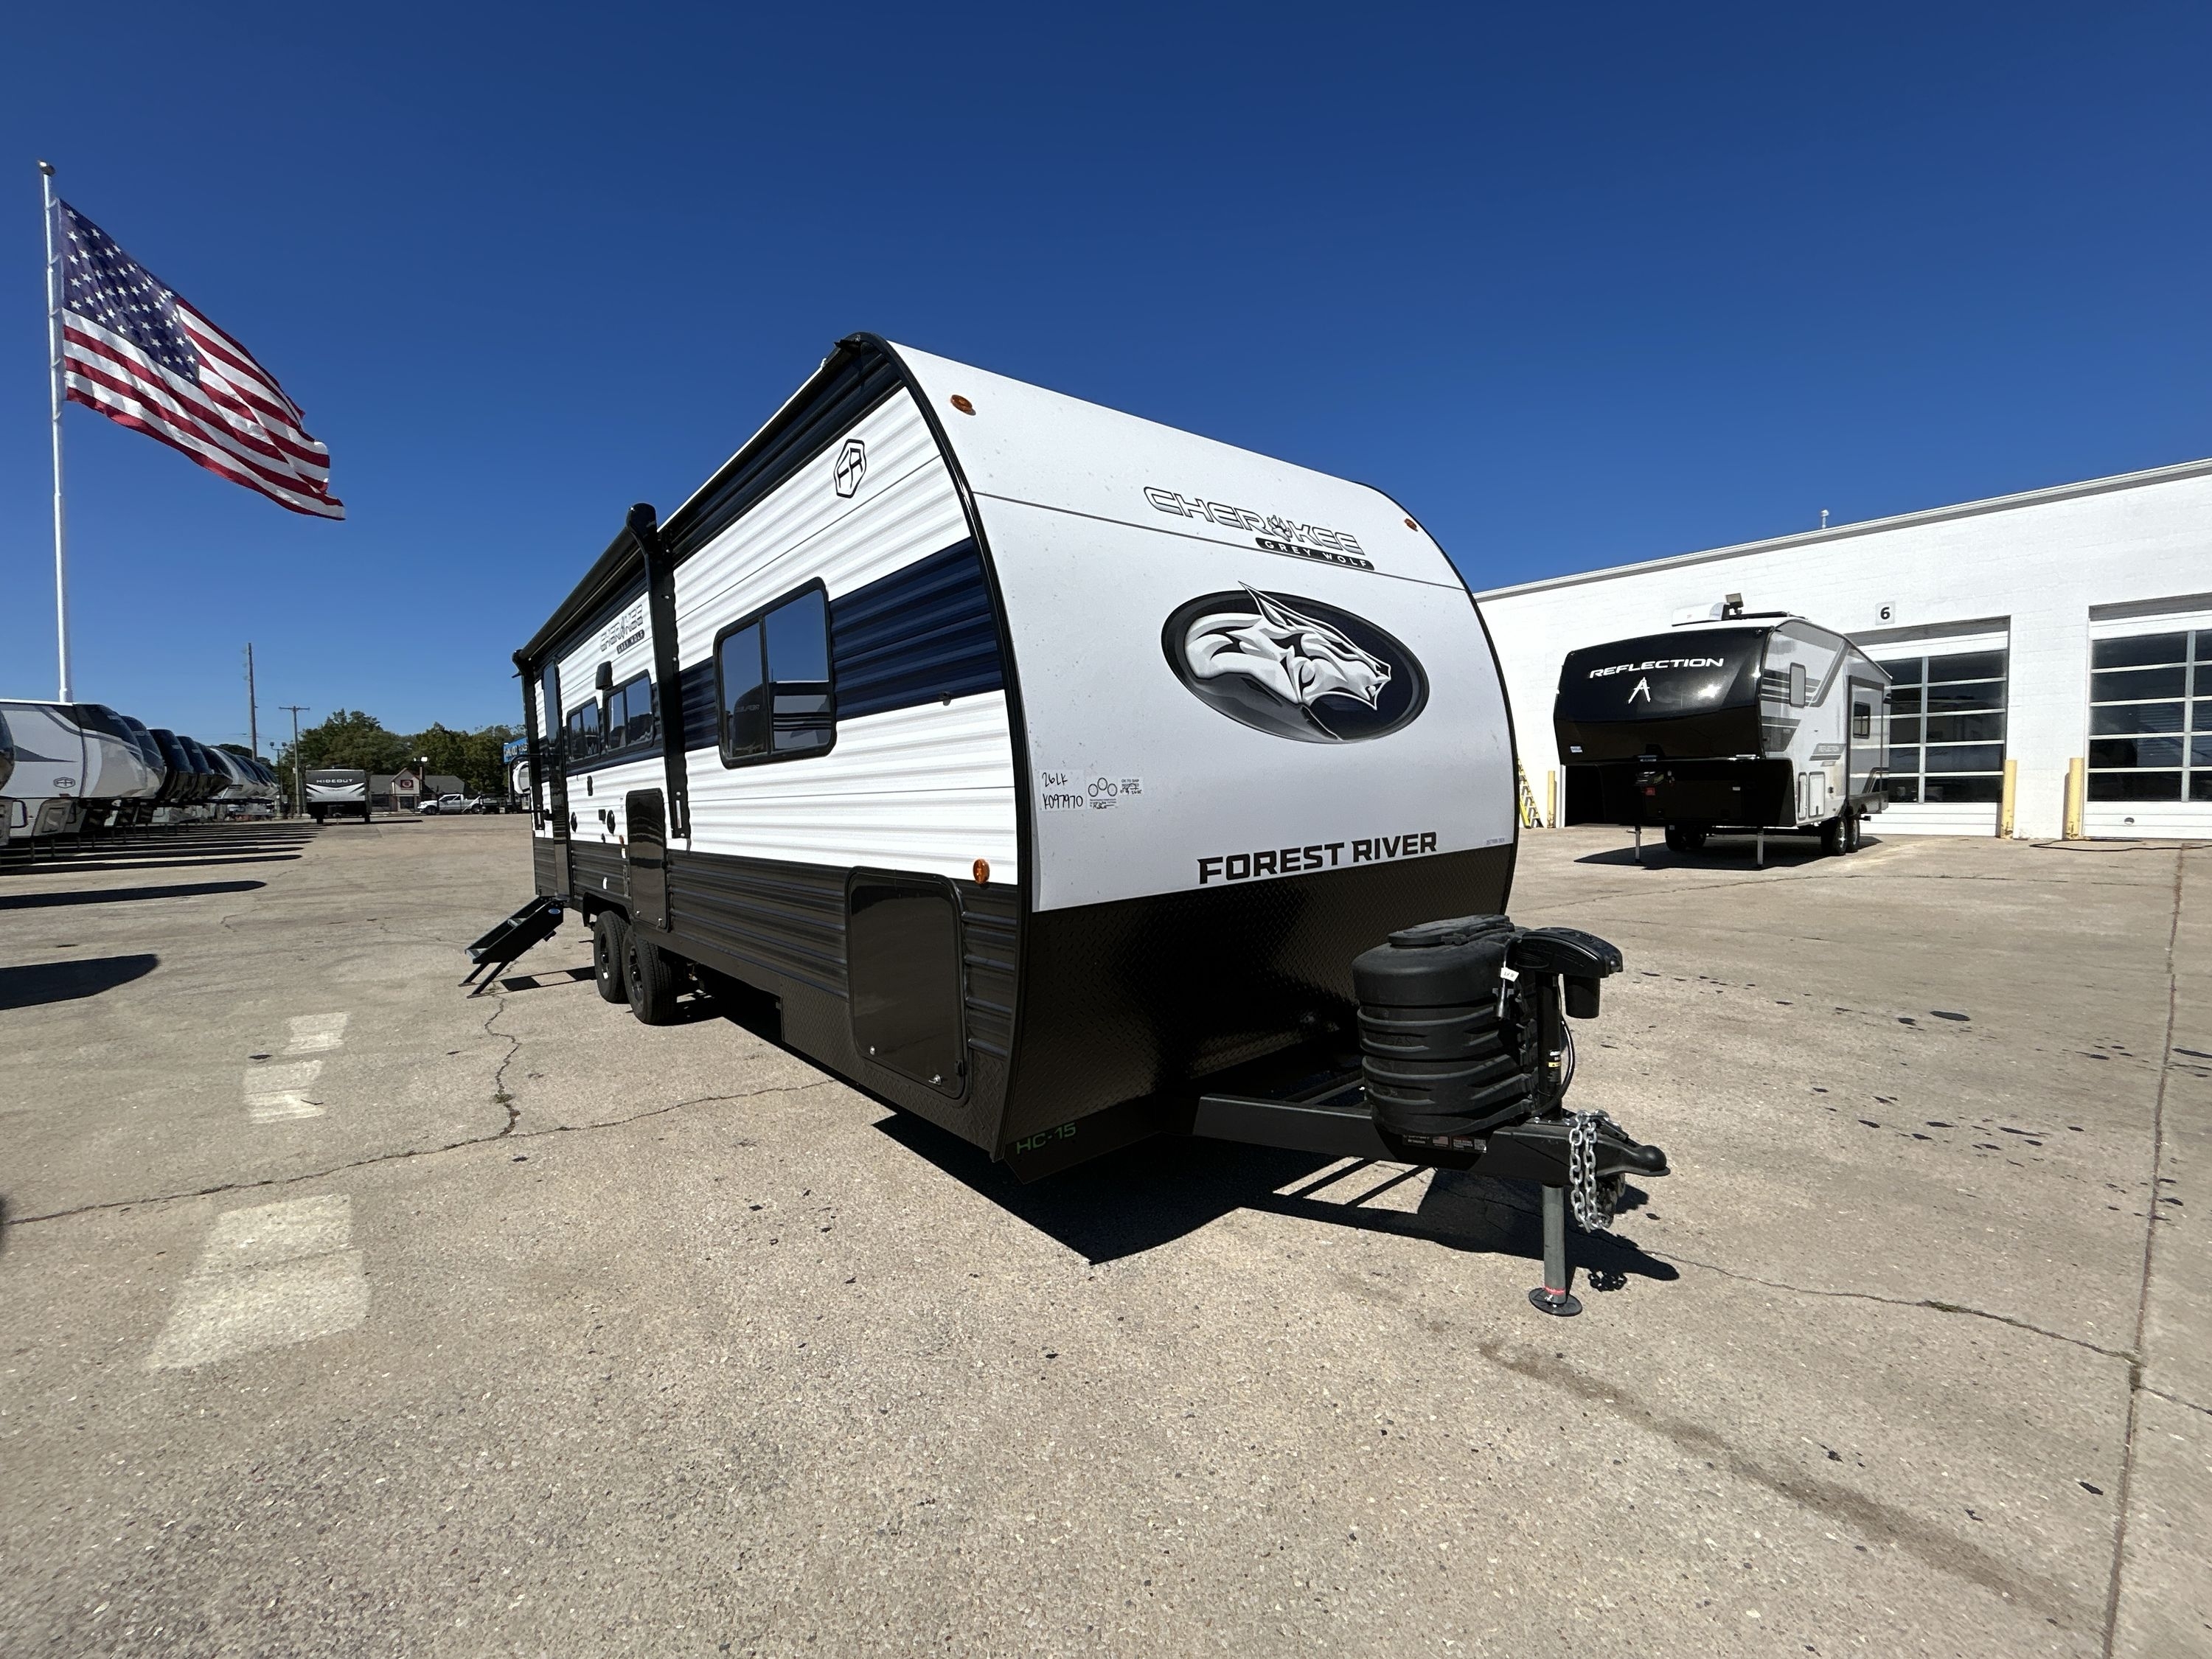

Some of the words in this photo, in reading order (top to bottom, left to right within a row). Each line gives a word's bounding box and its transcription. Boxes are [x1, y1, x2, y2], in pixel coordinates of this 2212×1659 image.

[1265, 541, 1311, 555] GREY
[1323, 552, 1367, 566] WOLF
[1880, 606, 1891, 620] 6
[1589, 658, 1725, 679] REFLECTION
[1197, 842, 1345, 885] FOREST
[1350, 831, 1437, 863] RIVER
[1016, 1122, 1077, 1155] HC-15
